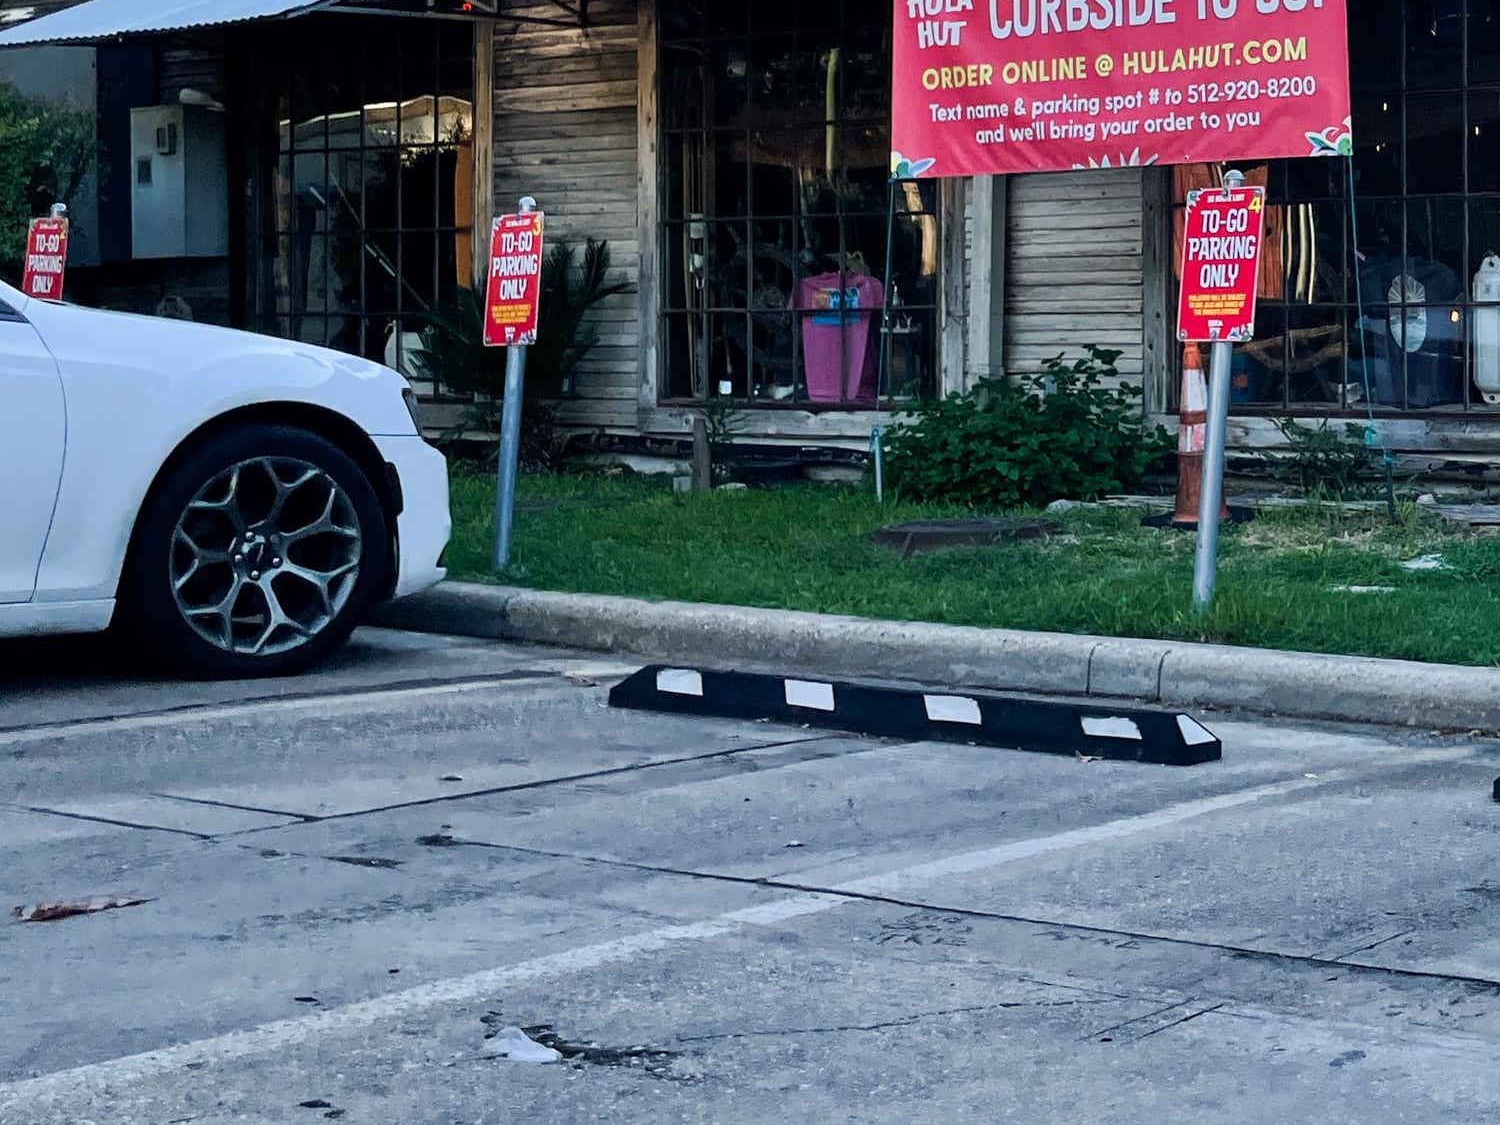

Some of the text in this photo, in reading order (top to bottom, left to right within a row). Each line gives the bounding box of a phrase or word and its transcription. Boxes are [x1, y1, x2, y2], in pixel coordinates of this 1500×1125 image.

[917, 20, 967, 49] HUT
[922, 37, 1307, 90] ORDER ONLINE @ HULAHUT.COM
[929, 76, 1316, 122] Text name & parking spot # to 512-920-8200
[976, 111, 1260, 144] and we'll bring your order to you
[1248, 196, 1262, 214] 4
[532, 218, 541, 236] 3
[1200, 207, 1248, 234] TO-GO
[35, 233, 60, 253] TO-GO
[501, 231, 533, 254] TO-GO
[1188, 234, 1256, 262] PARKING
[28, 255, 62, 274] PARKING
[492, 254, 538, 278] PARKING
[1199, 263, 1239, 289] ONLY
[32, 275, 53, 294] ONLY
[499, 278, 527, 301] ONLY
